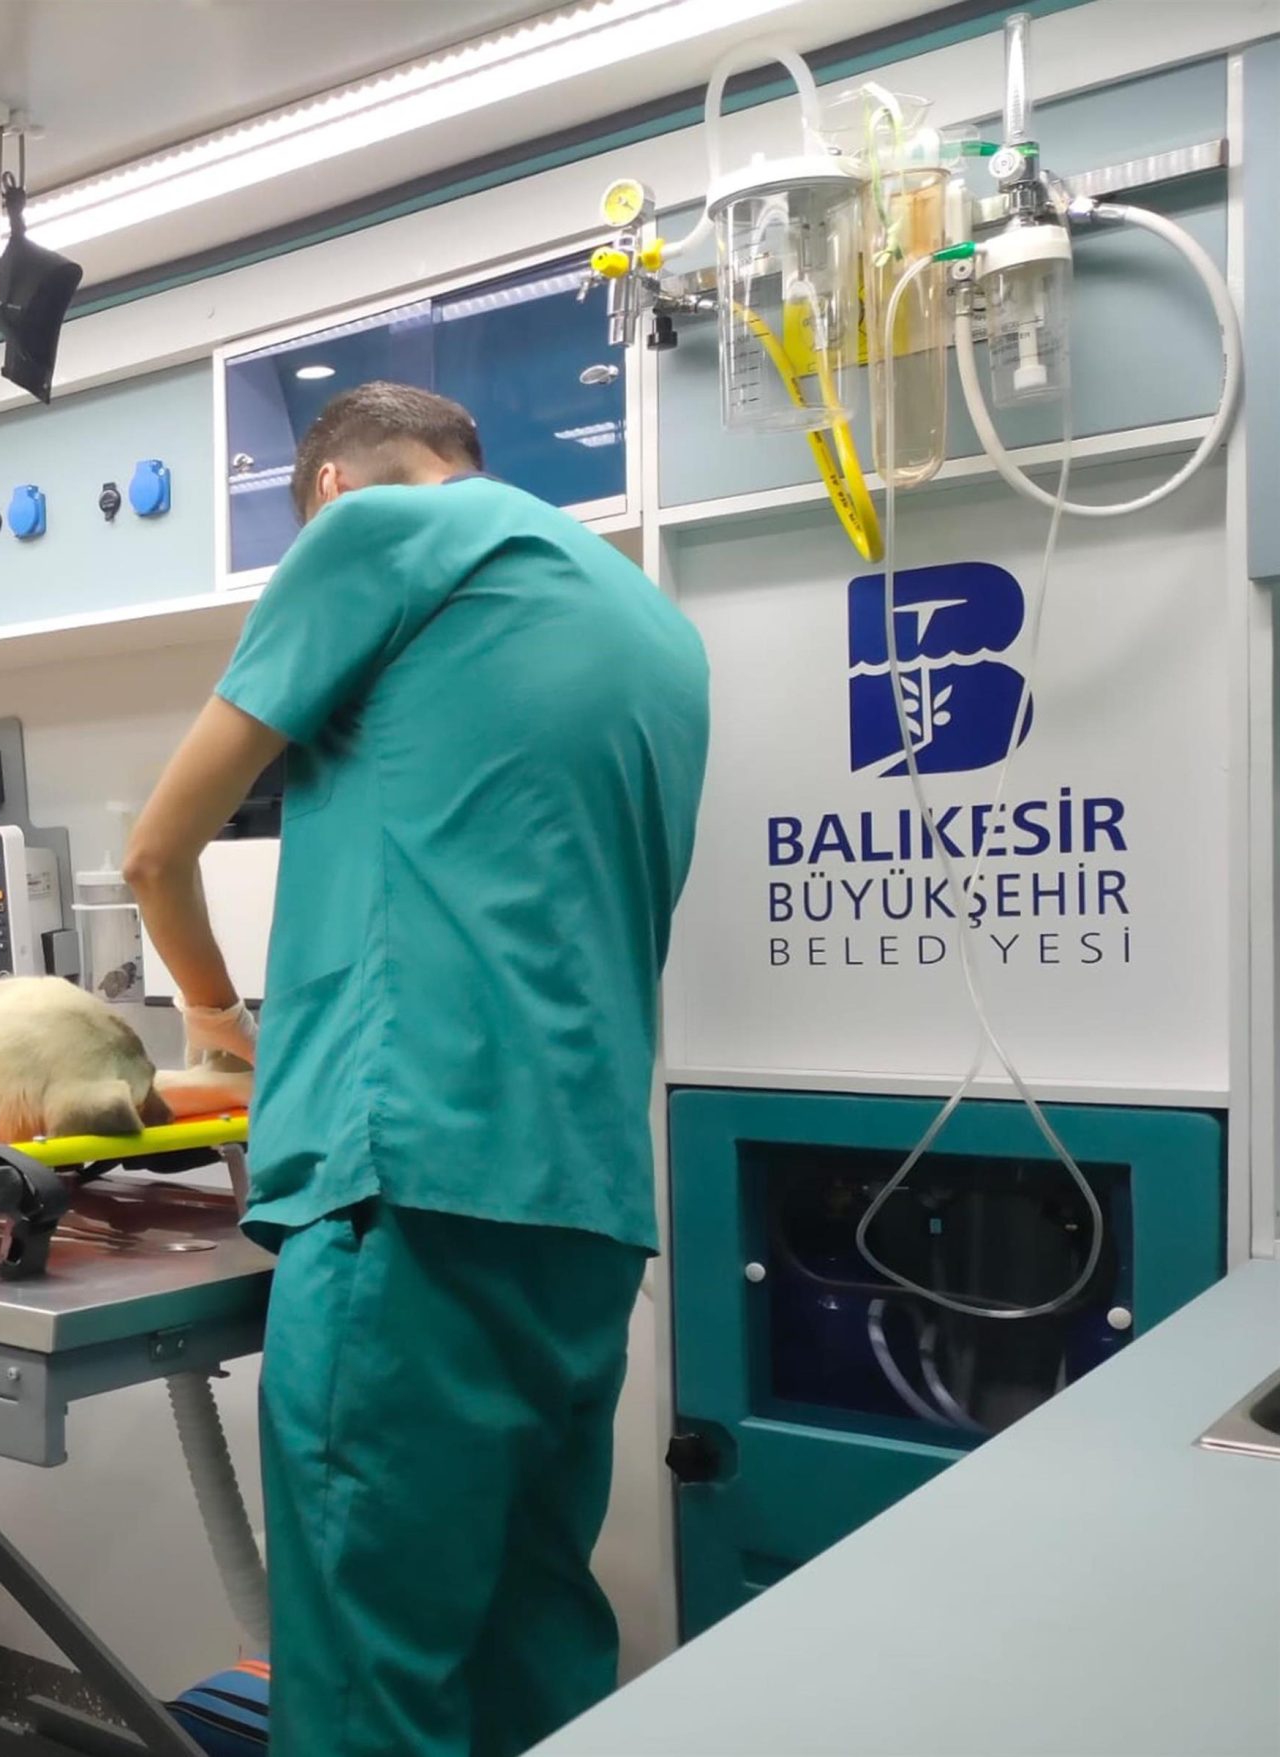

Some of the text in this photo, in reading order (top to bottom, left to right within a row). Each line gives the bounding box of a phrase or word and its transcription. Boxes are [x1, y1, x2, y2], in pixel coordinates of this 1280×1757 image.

[767, 787, 1128, 866] BALIKESİR
[768, 862, 1130, 928] BÜYÜKŞEHİR
[769, 927, 1131, 966] BELEDYESİ
